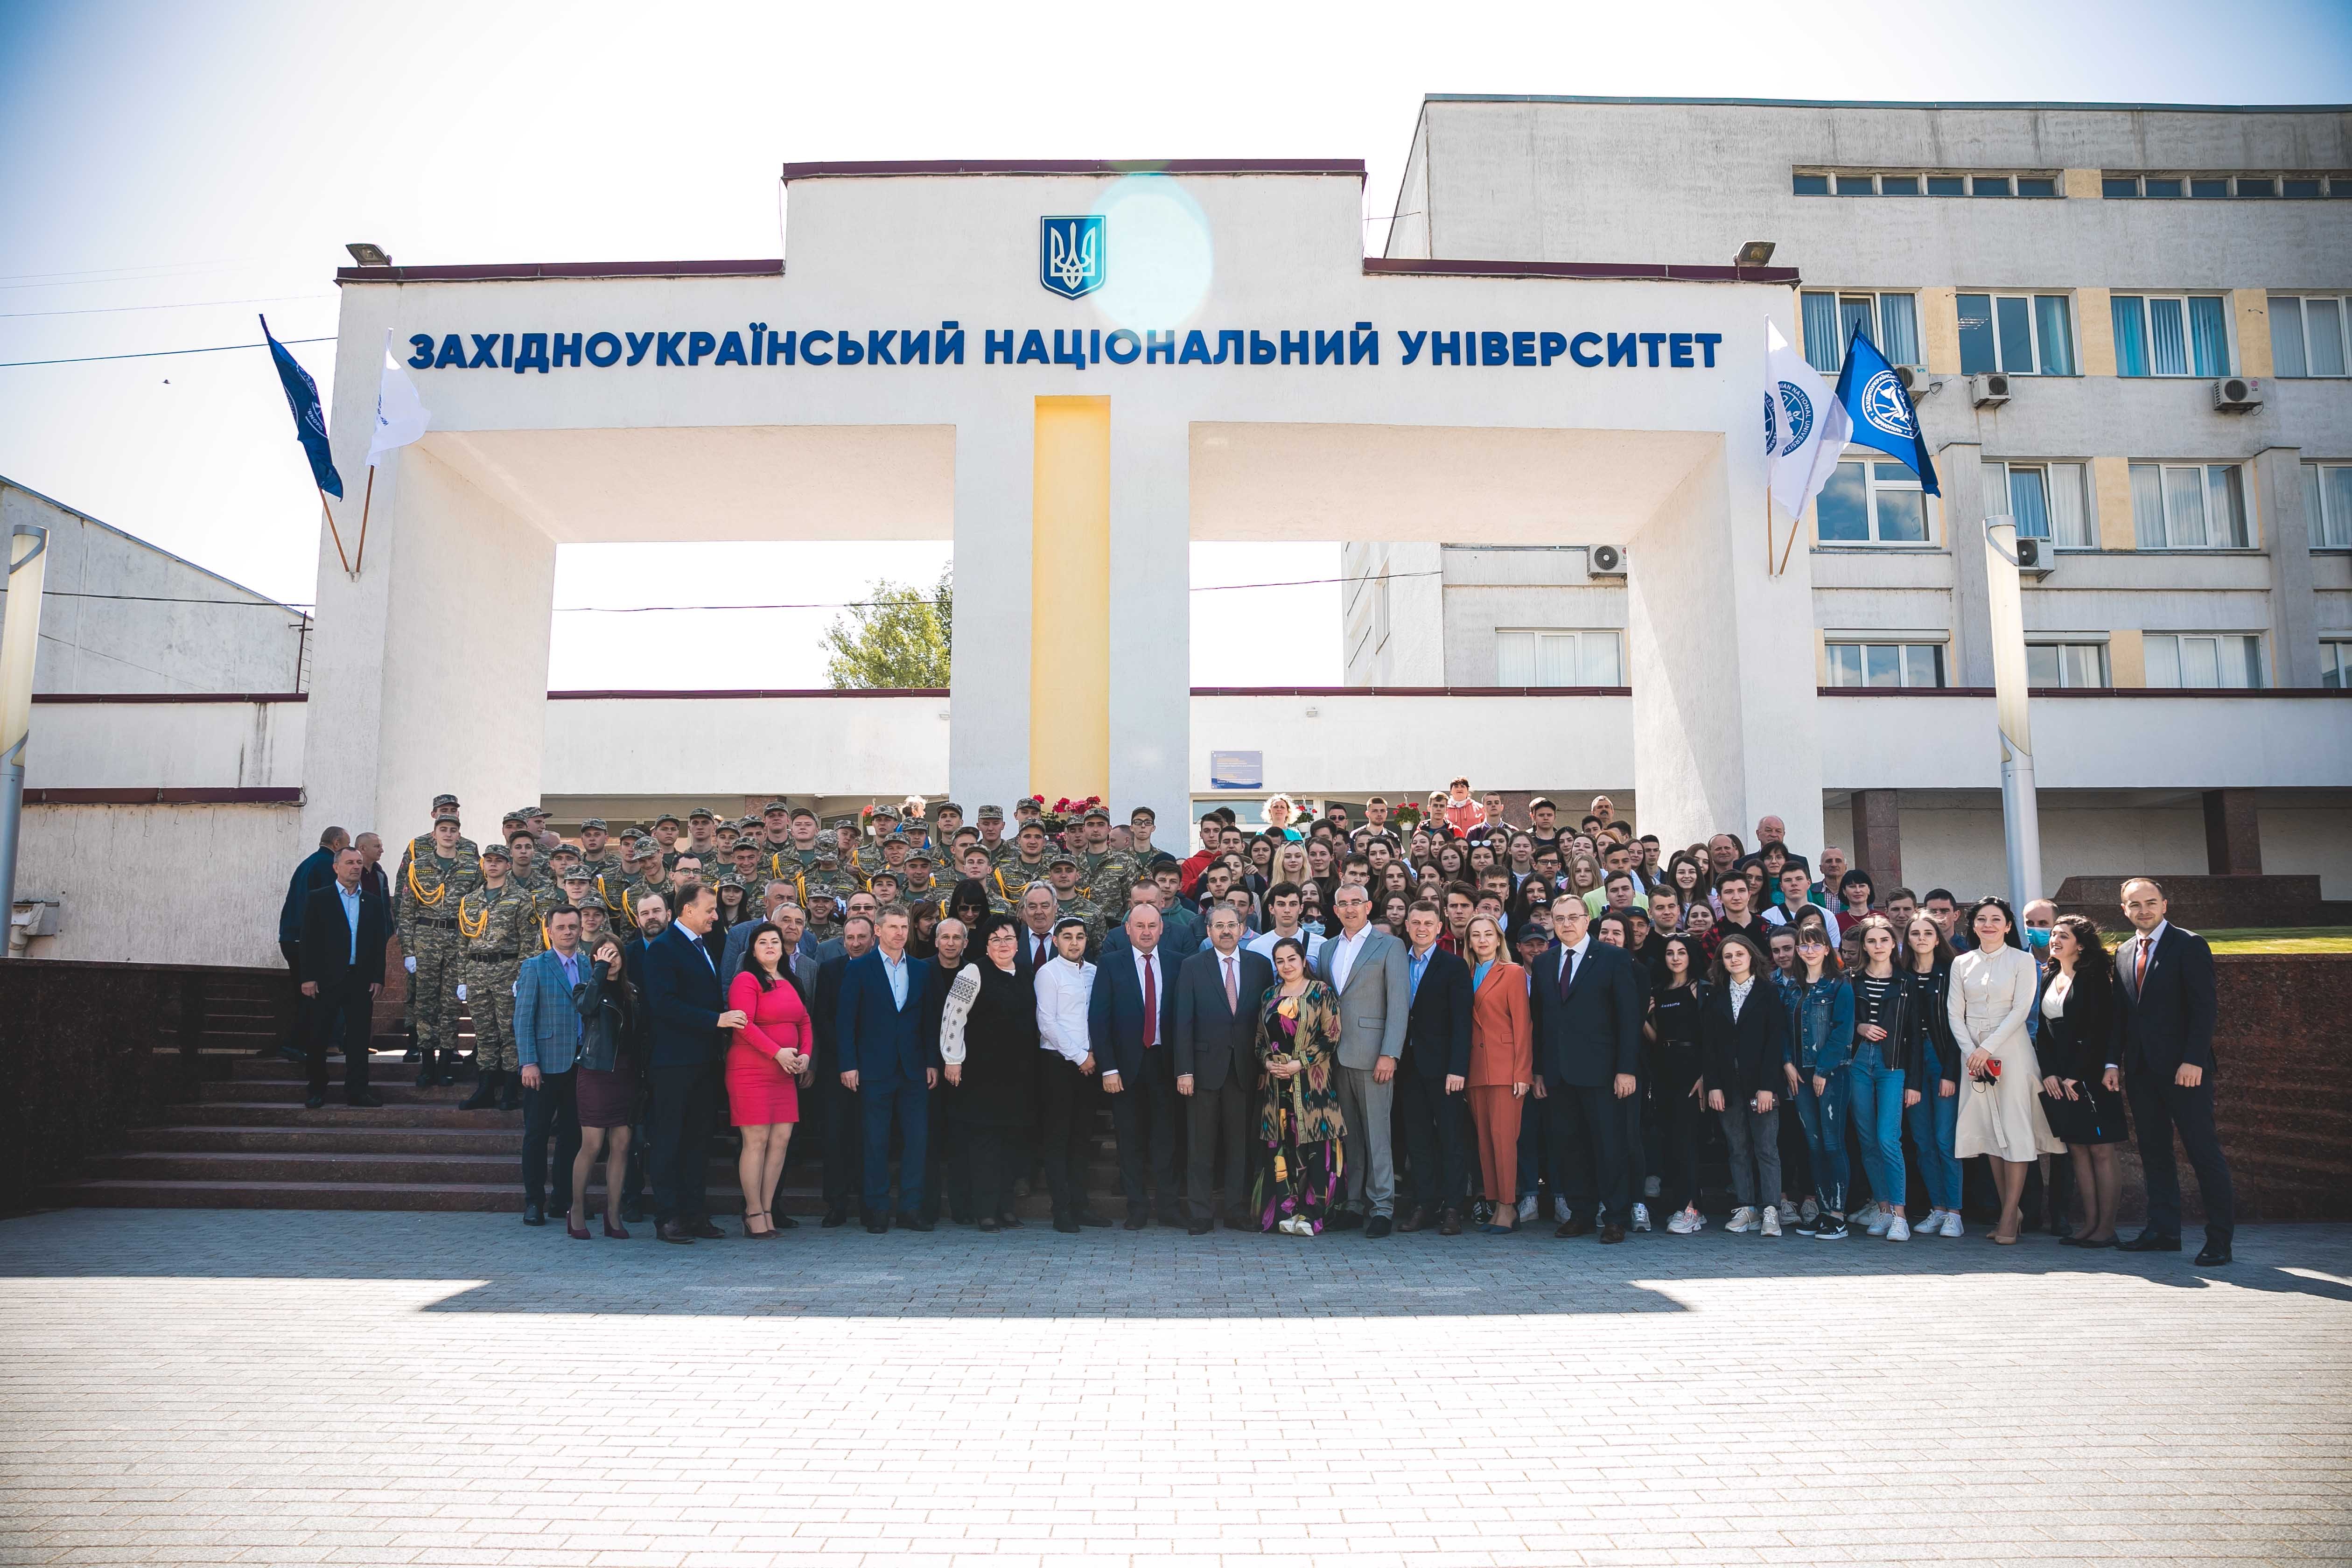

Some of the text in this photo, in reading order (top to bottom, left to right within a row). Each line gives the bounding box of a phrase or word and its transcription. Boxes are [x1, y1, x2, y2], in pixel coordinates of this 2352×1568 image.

[408, 321, 1722, 374] ЗАХІДНОУКРАЇНСЬКИЙ НАЦІОНАЛЬНИЙ УНІВЕРСИТЕТ
[1866, 374, 1897, 413] ЗАХІДНОУКРАЇНСЬК
[308, 408, 323, 431] RNOPIL
[1784, 387, 1811, 454] NATIONAL UNIVERSITY
